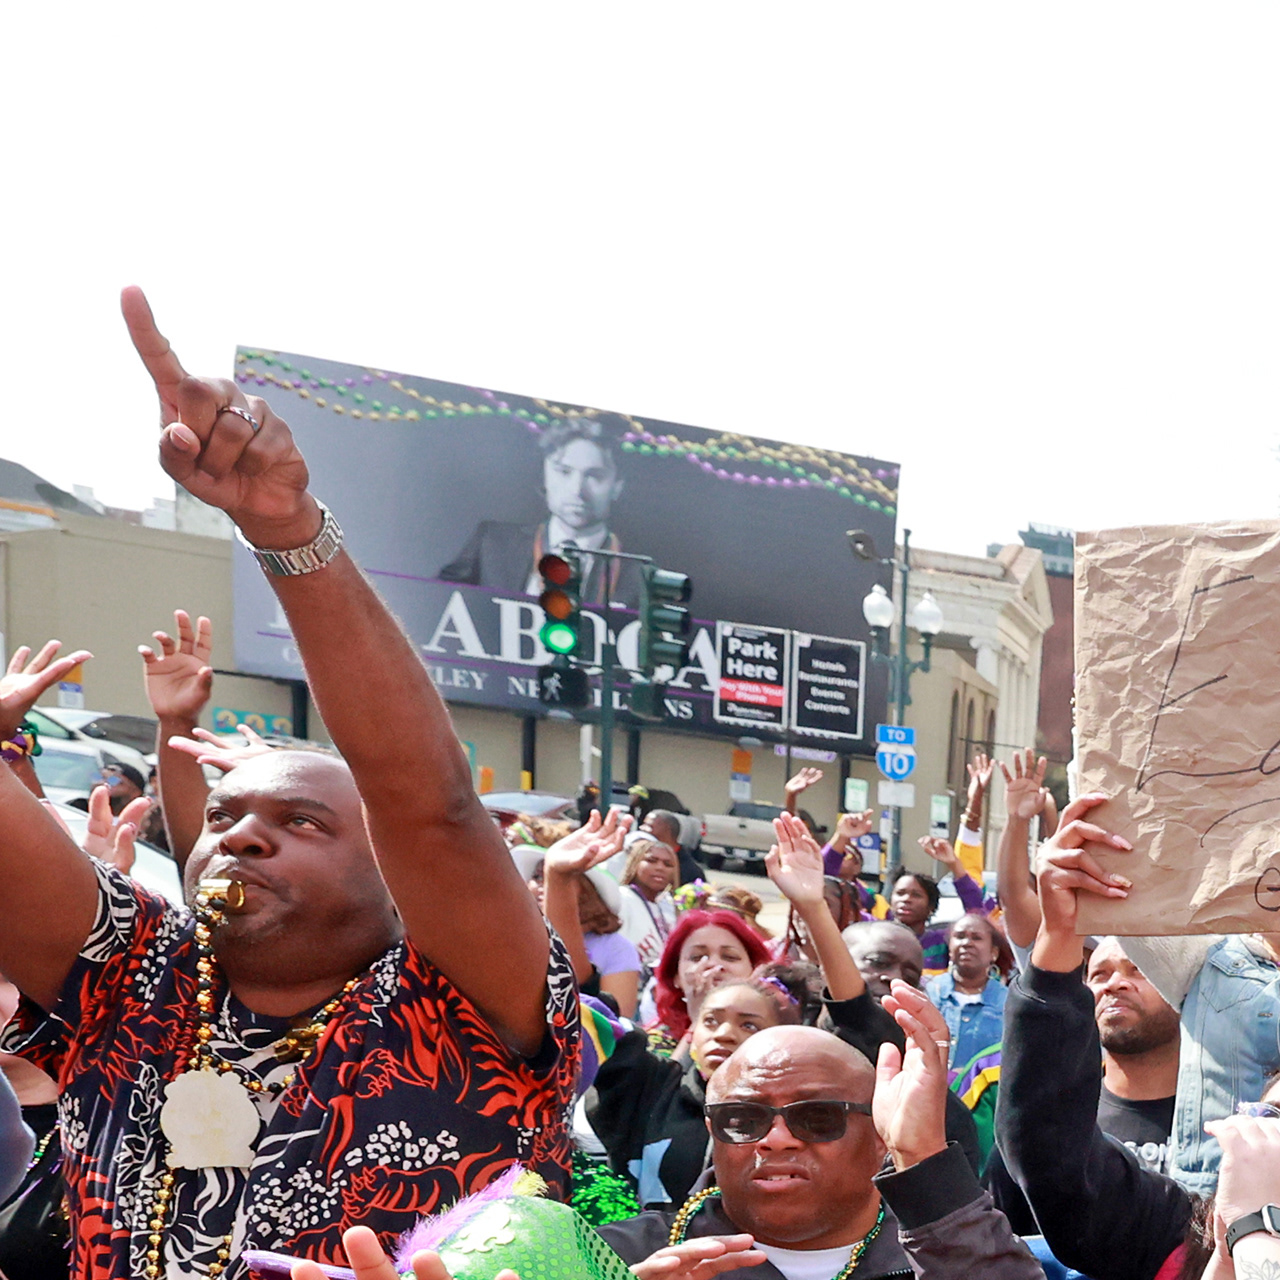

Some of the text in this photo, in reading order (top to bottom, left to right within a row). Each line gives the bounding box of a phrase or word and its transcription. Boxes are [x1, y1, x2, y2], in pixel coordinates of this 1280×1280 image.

[727, 637, 778, 660] Park
[726, 657, 779, 681] Here
[886, 728, 906, 742] TO
[884, 752, 909, 775] 10
